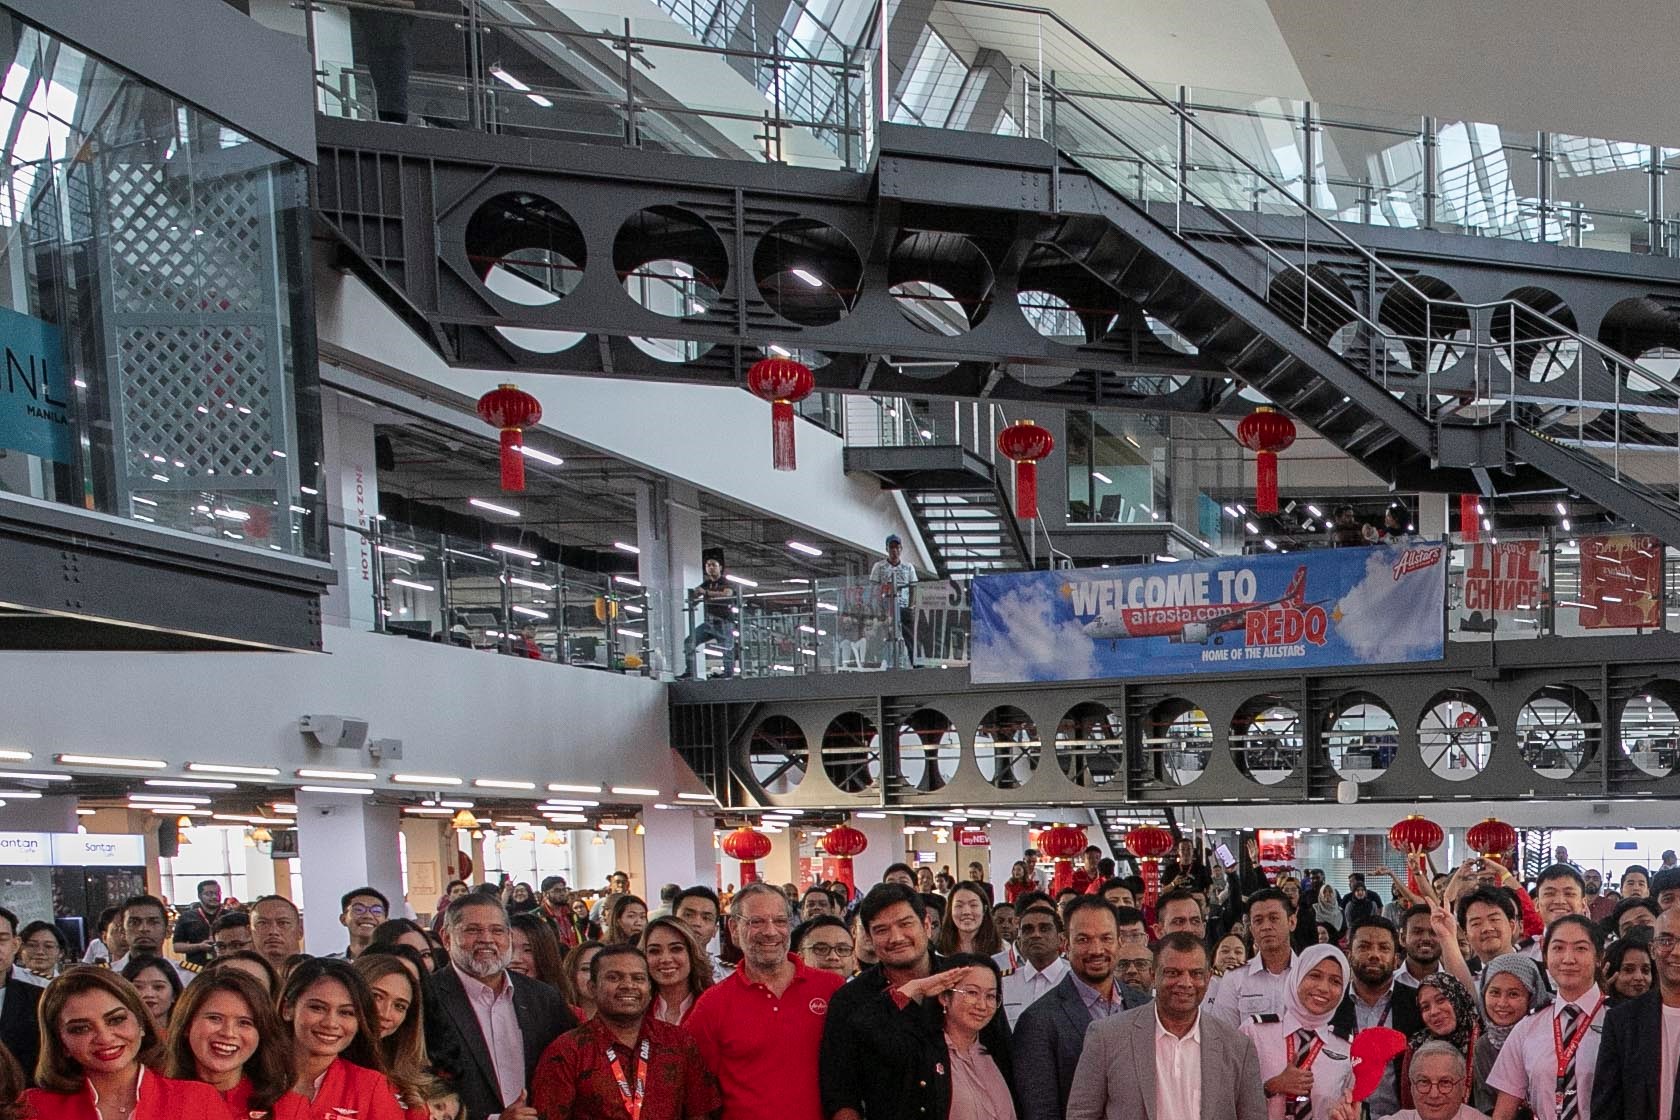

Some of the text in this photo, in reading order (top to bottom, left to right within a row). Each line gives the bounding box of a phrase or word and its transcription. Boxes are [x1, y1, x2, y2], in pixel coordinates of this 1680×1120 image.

[0, 347, 66, 408] NL
[27, 404, 68, 425] MANILA
[355, 464, 369, 581] HOT DSK ZONE
[1394, 549, 1440, 580] Allstars
[1071, 569, 1258, 616] WELCOME TO
[1131, 605, 1233, 625] airasia.com
[1245, 605, 1329, 647] REDQ
[1202, 644, 1306, 662] HOME OF THE ALLSTARS
[0, 839, 38, 848] antan
[85, 842, 116, 852] Santan
